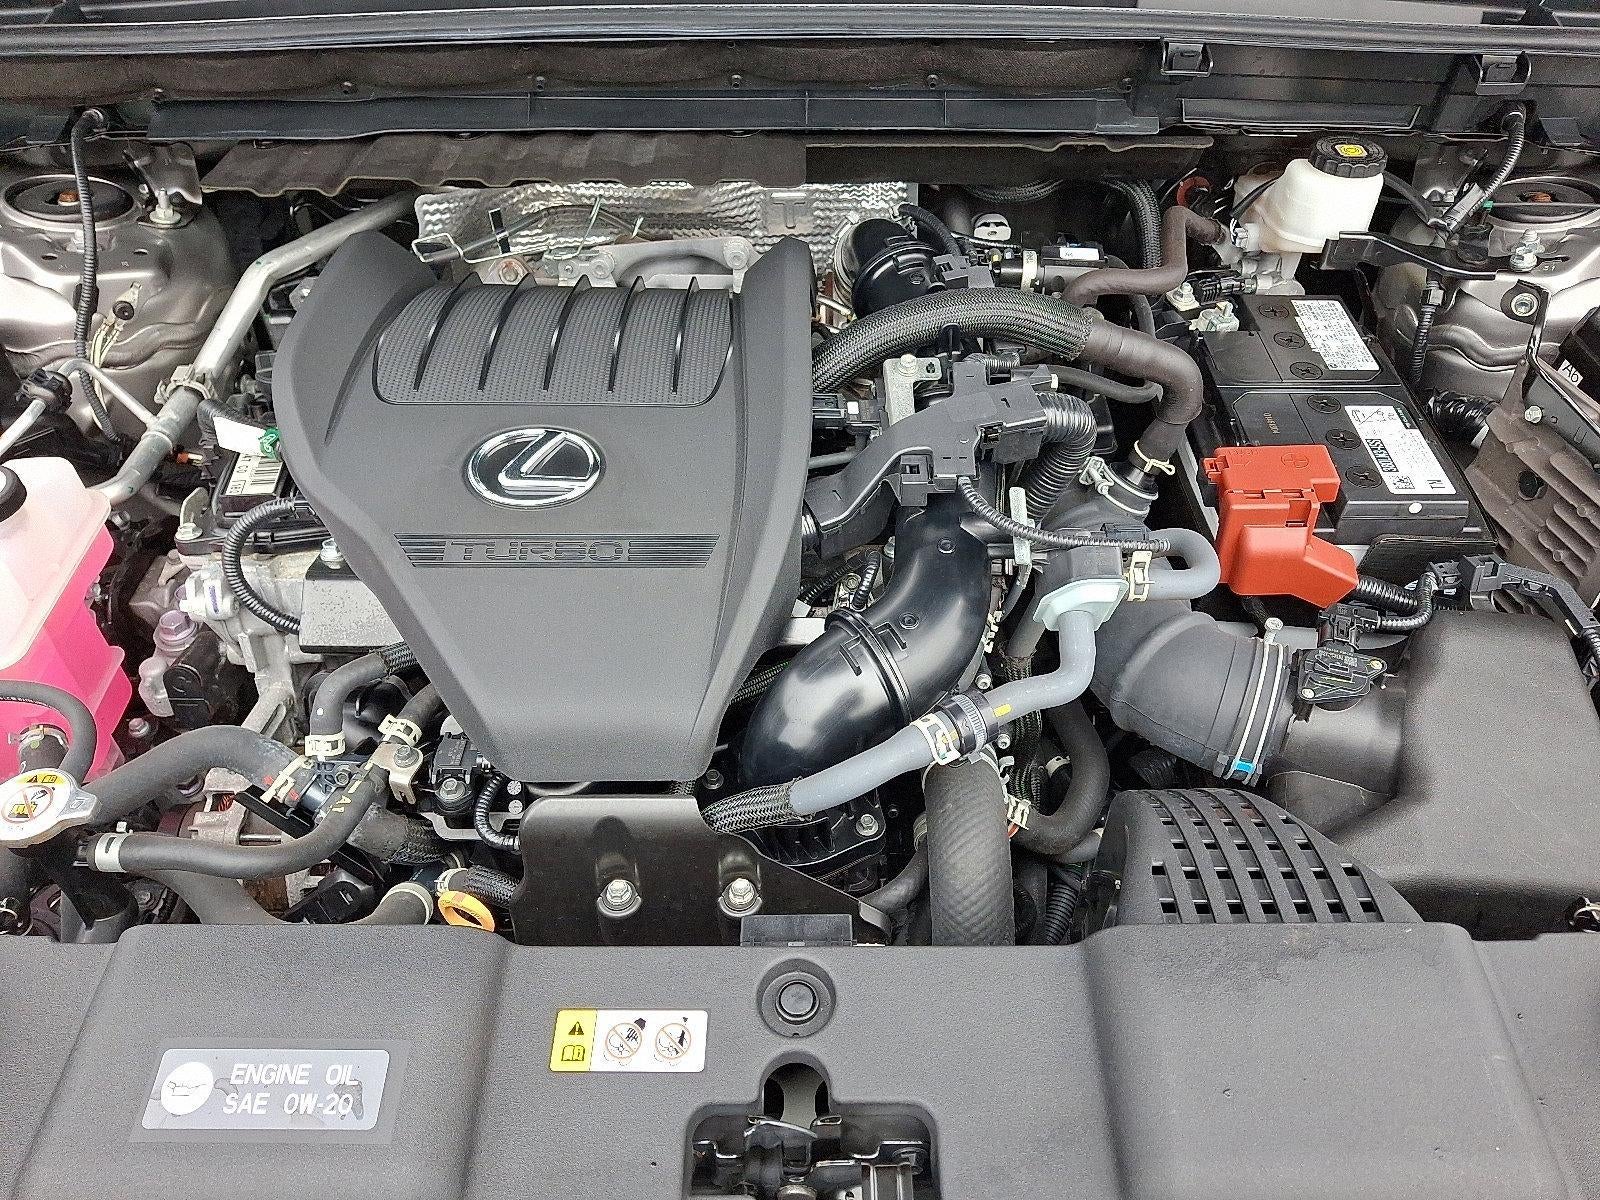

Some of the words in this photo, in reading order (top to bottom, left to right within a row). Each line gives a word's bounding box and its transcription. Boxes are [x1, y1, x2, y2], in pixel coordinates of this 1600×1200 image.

[450, 540, 624, 562] TURBO
[229, 1062, 313, 1086] ENGINE
[324, 1063, 360, 1087] OIL
[221, 1091, 271, 1116] SAE
[282, 1092, 354, 1116] 0W-20
